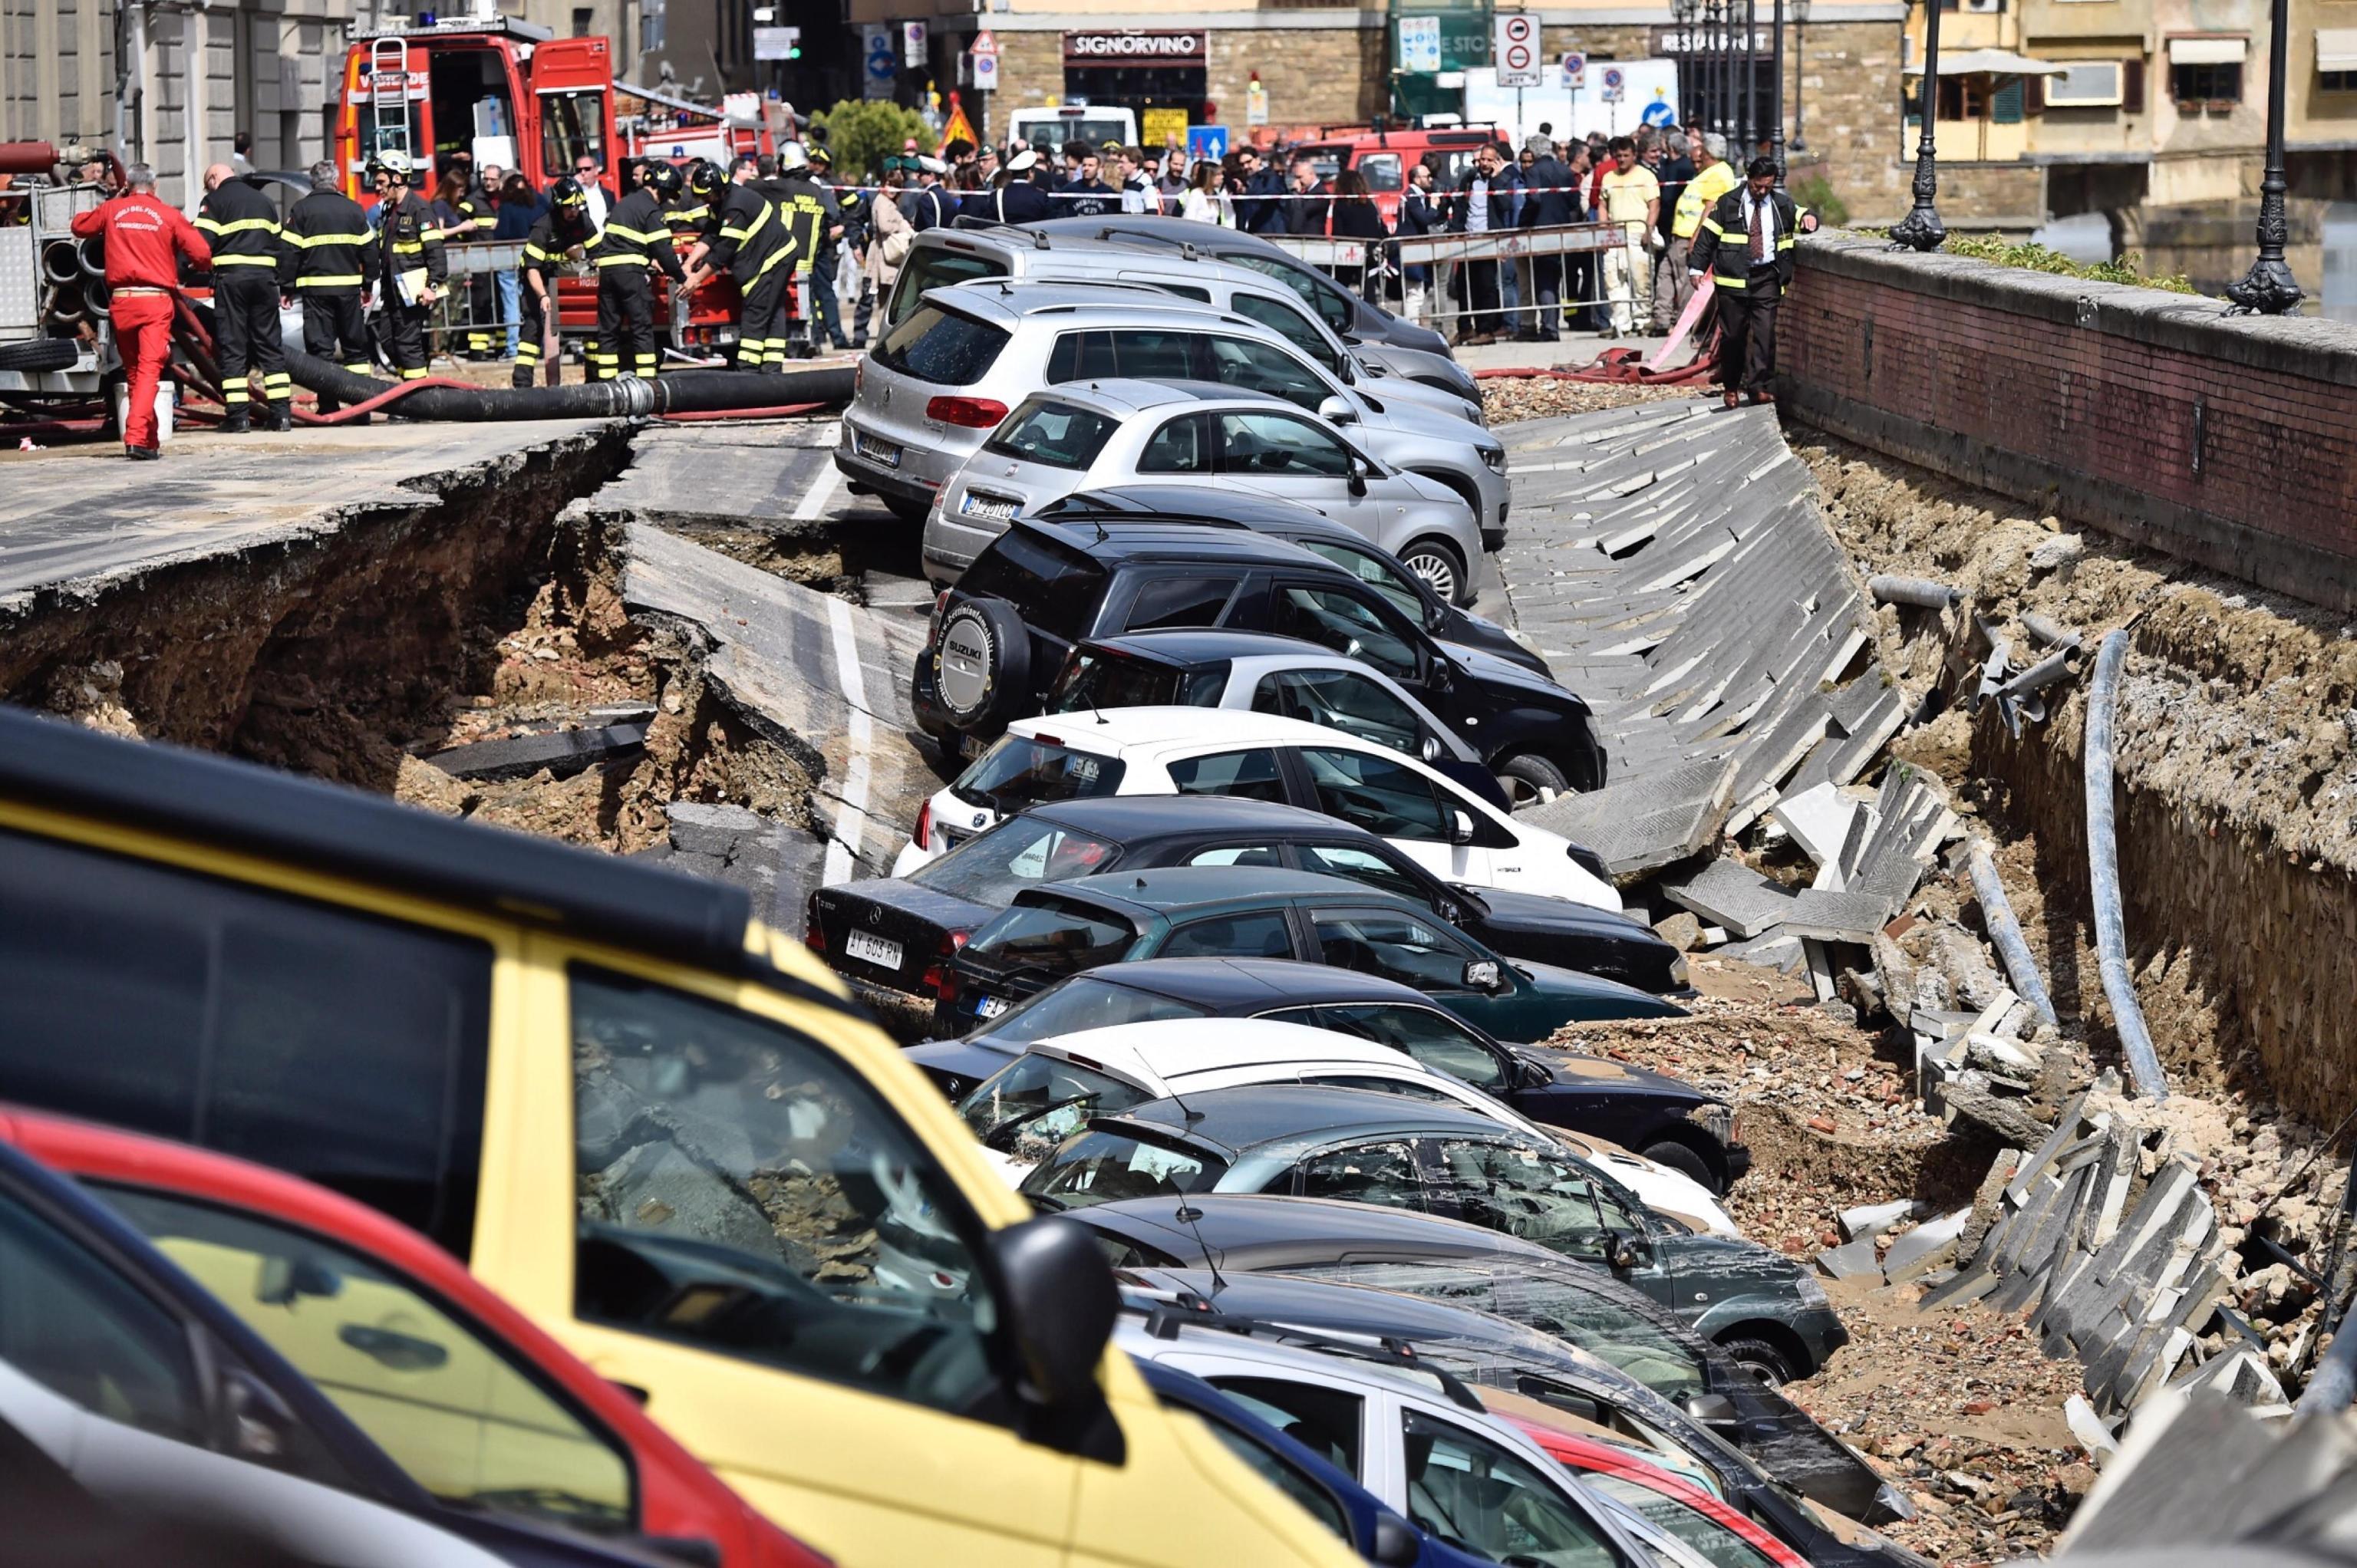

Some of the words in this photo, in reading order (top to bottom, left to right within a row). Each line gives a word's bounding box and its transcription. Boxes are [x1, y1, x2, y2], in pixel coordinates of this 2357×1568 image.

[1075, 35, 1196, 54] SIGNORVINO
[143, 207, 163, 226] FUOCO
[949, 640, 981, 660] SUZUKI
[849, 931, 864, 952] AY
[865, 937, 885, 958] 603
[885, 941, 902, 964] RN
